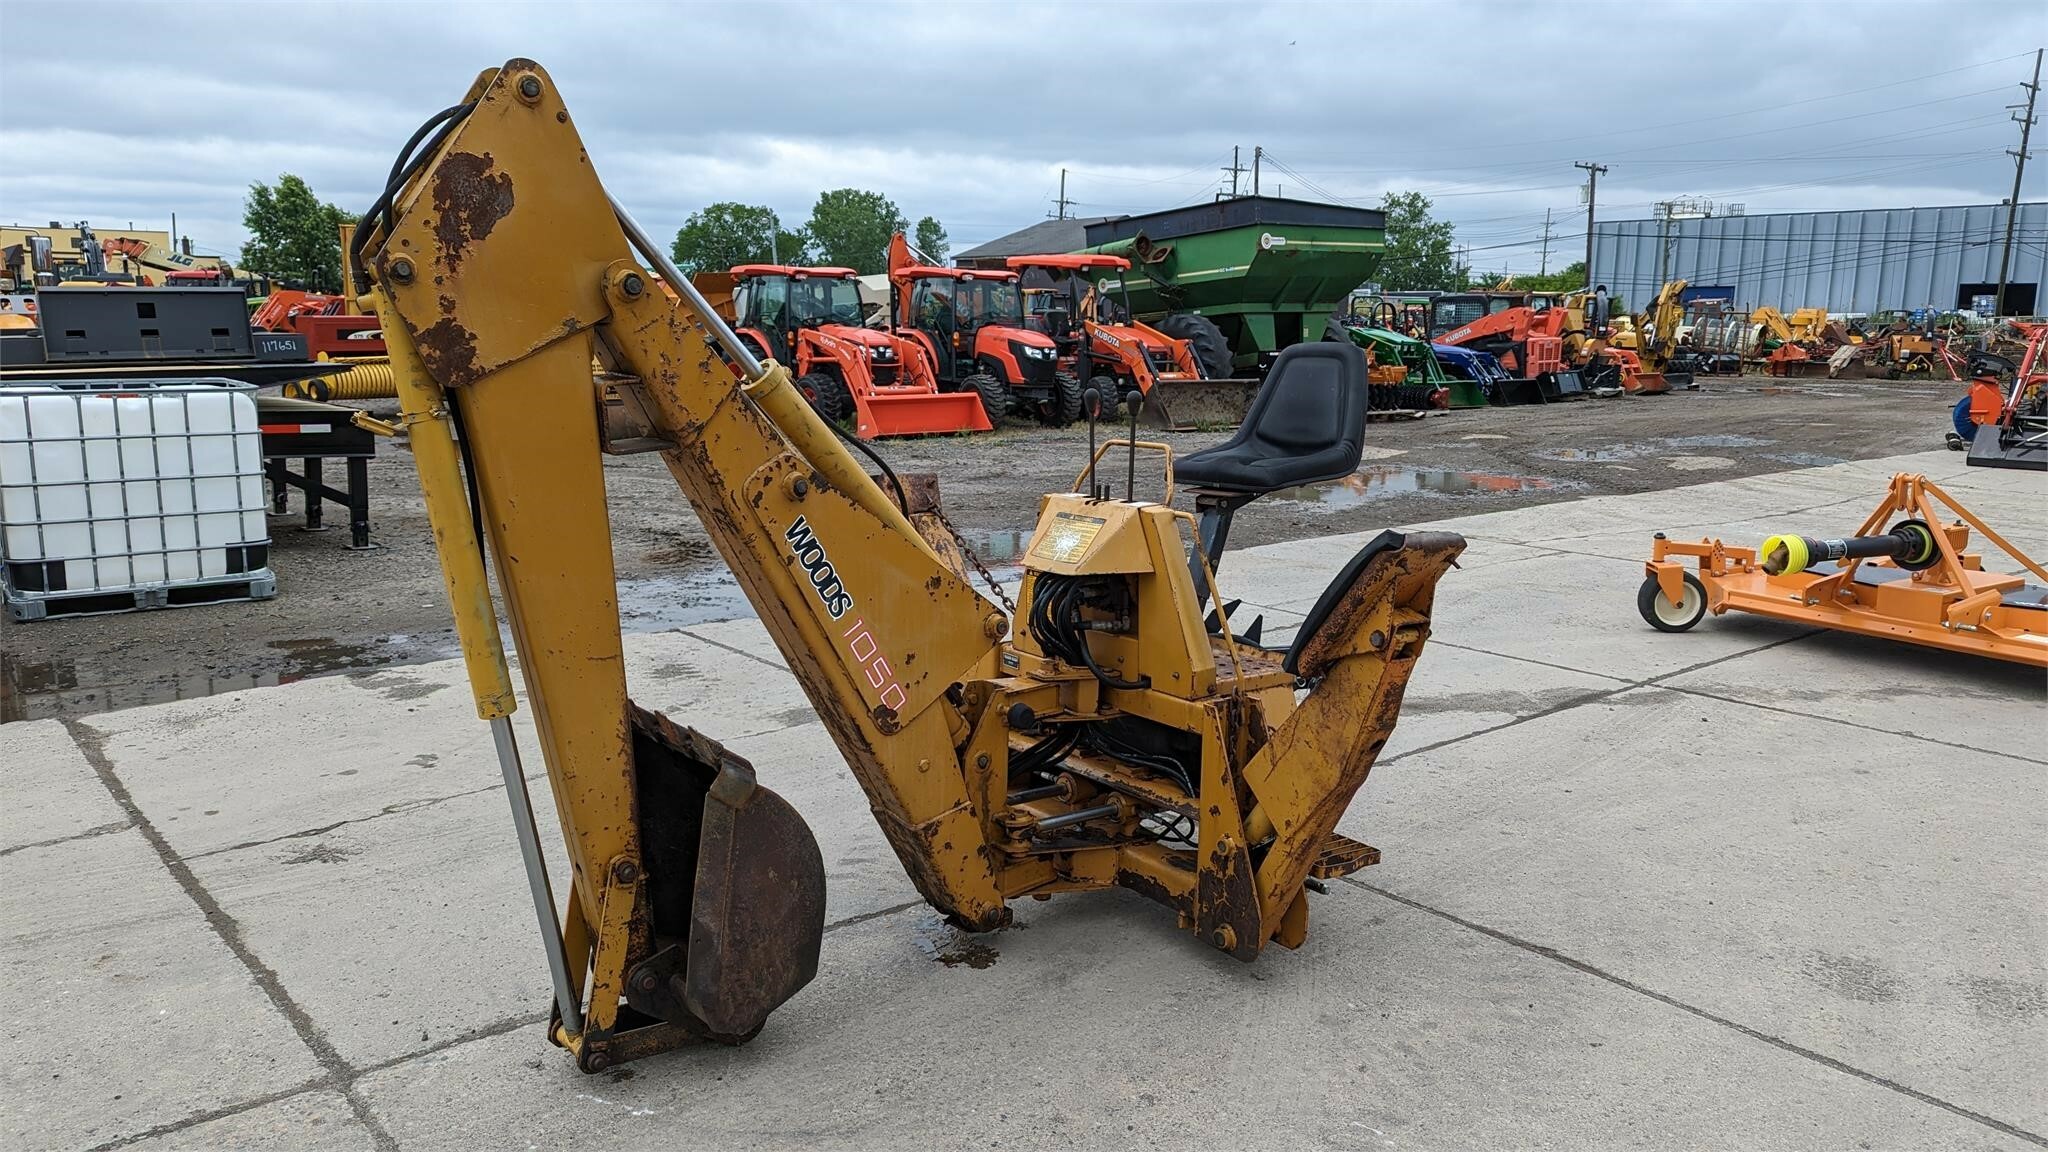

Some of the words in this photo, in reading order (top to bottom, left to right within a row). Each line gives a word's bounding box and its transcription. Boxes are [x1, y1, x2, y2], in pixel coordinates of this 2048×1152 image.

[167, 254, 194, 266] JLG
[1094, 328, 1120, 348] KUBOTA
[1445, 327, 1472, 344] KUBOTA
[262, 340, 296, 353] 117651
[785, 514, 854, 620] WOODS
[843, 617, 906, 711] 1050
